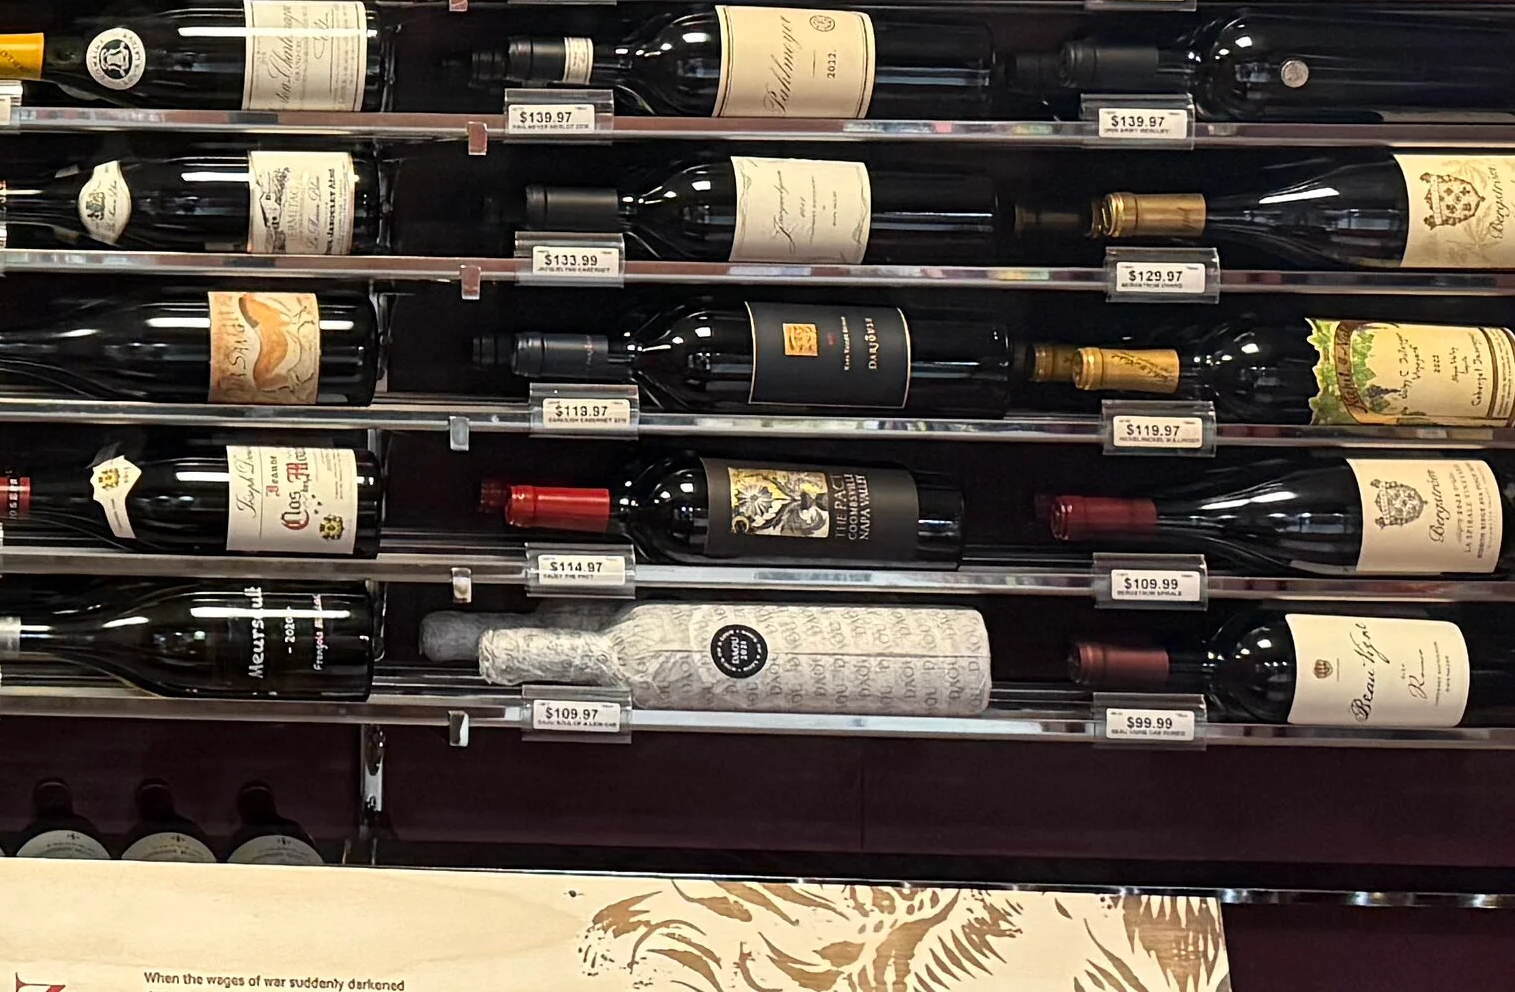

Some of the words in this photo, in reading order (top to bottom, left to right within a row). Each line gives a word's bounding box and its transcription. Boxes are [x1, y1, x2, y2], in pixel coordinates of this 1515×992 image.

[519, 111, 572, 124] $139.97
[1111, 115, 1165, 127] $139.97
[544, 253, 598, 266] $133.99
[1128, 270, 1183, 282] $129.97
[555, 404, 608, 418] $119.97
[1126, 423, 1180, 437] $119.97
[832, 475, 847, 510] PACT
[855, 474, 871, 504] VALLEY
[844, 474, 858, 540] COOMBSVILLE
[834, 513, 848, 537] THE
[859, 506, 871, 540] NAPA
[550, 561, 603, 573] $114.97
[1124, 577, 1178, 590] $109.99
[731, 637, 741, 664] DAOU
[1349, 669, 1376, 722] Beau
[545, 706, 598, 720] $109.97
[1126, 716, 1173, 730] $99.99
[144, 971, 179, 984] When
[183, 973, 203, 985] the
[207, 975, 245, 988] wages
[249, 974, 262, 986] of
[264, 977, 286, 987] war
[290, 977, 344, 992] suddenly
[348, 978, 404, 992] darkened
